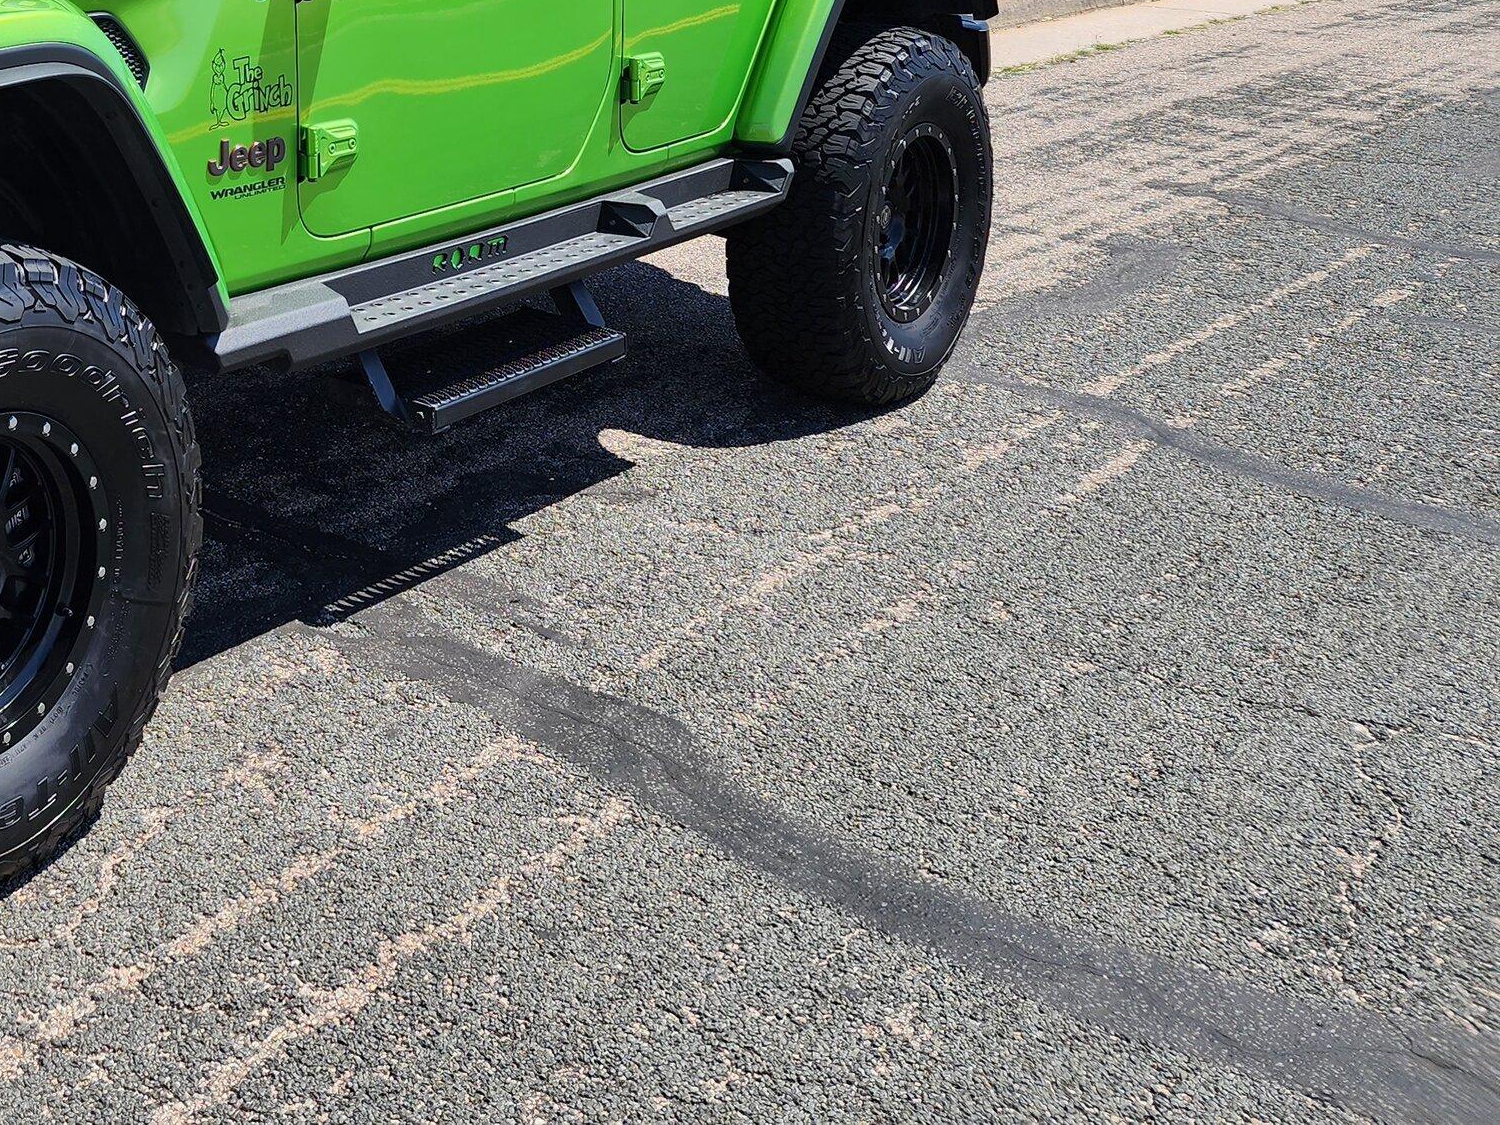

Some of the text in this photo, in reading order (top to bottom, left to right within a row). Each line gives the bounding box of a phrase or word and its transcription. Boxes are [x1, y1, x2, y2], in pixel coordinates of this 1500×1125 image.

[232, 55, 263, 87] The
[207, 136, 287, 177] Jeep
[210, 176, 286, 201] WRANGLER
[234, 184, 287, 201] UNLIMITED
